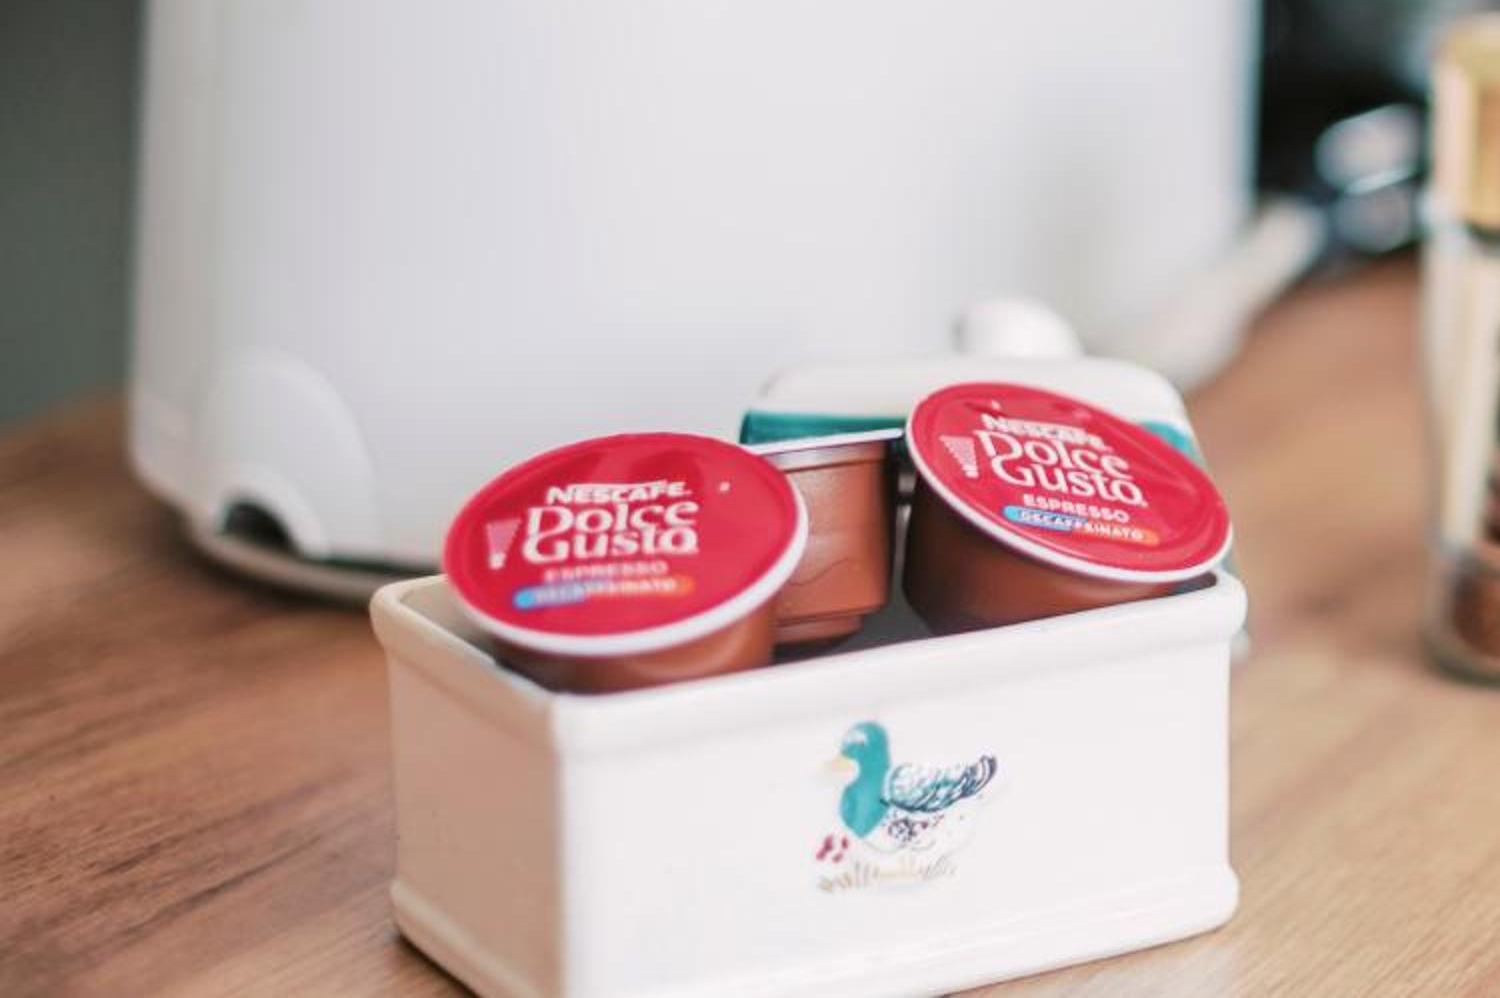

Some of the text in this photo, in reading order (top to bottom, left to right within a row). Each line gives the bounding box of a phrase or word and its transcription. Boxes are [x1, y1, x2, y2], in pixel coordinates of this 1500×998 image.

[974, 430, 1134, 480] Dolce
[991, 454, 1144, 506] Gusto
[527, 501, 699, 536] Dolce
[1018, 509, 1145, 541] DECAFFEINATO
[1023, 494, 1130, 523] ESPRESSO
[522, 527, 700, 564] Gusto
[544, 559, 669, 583] ESPRESSO
